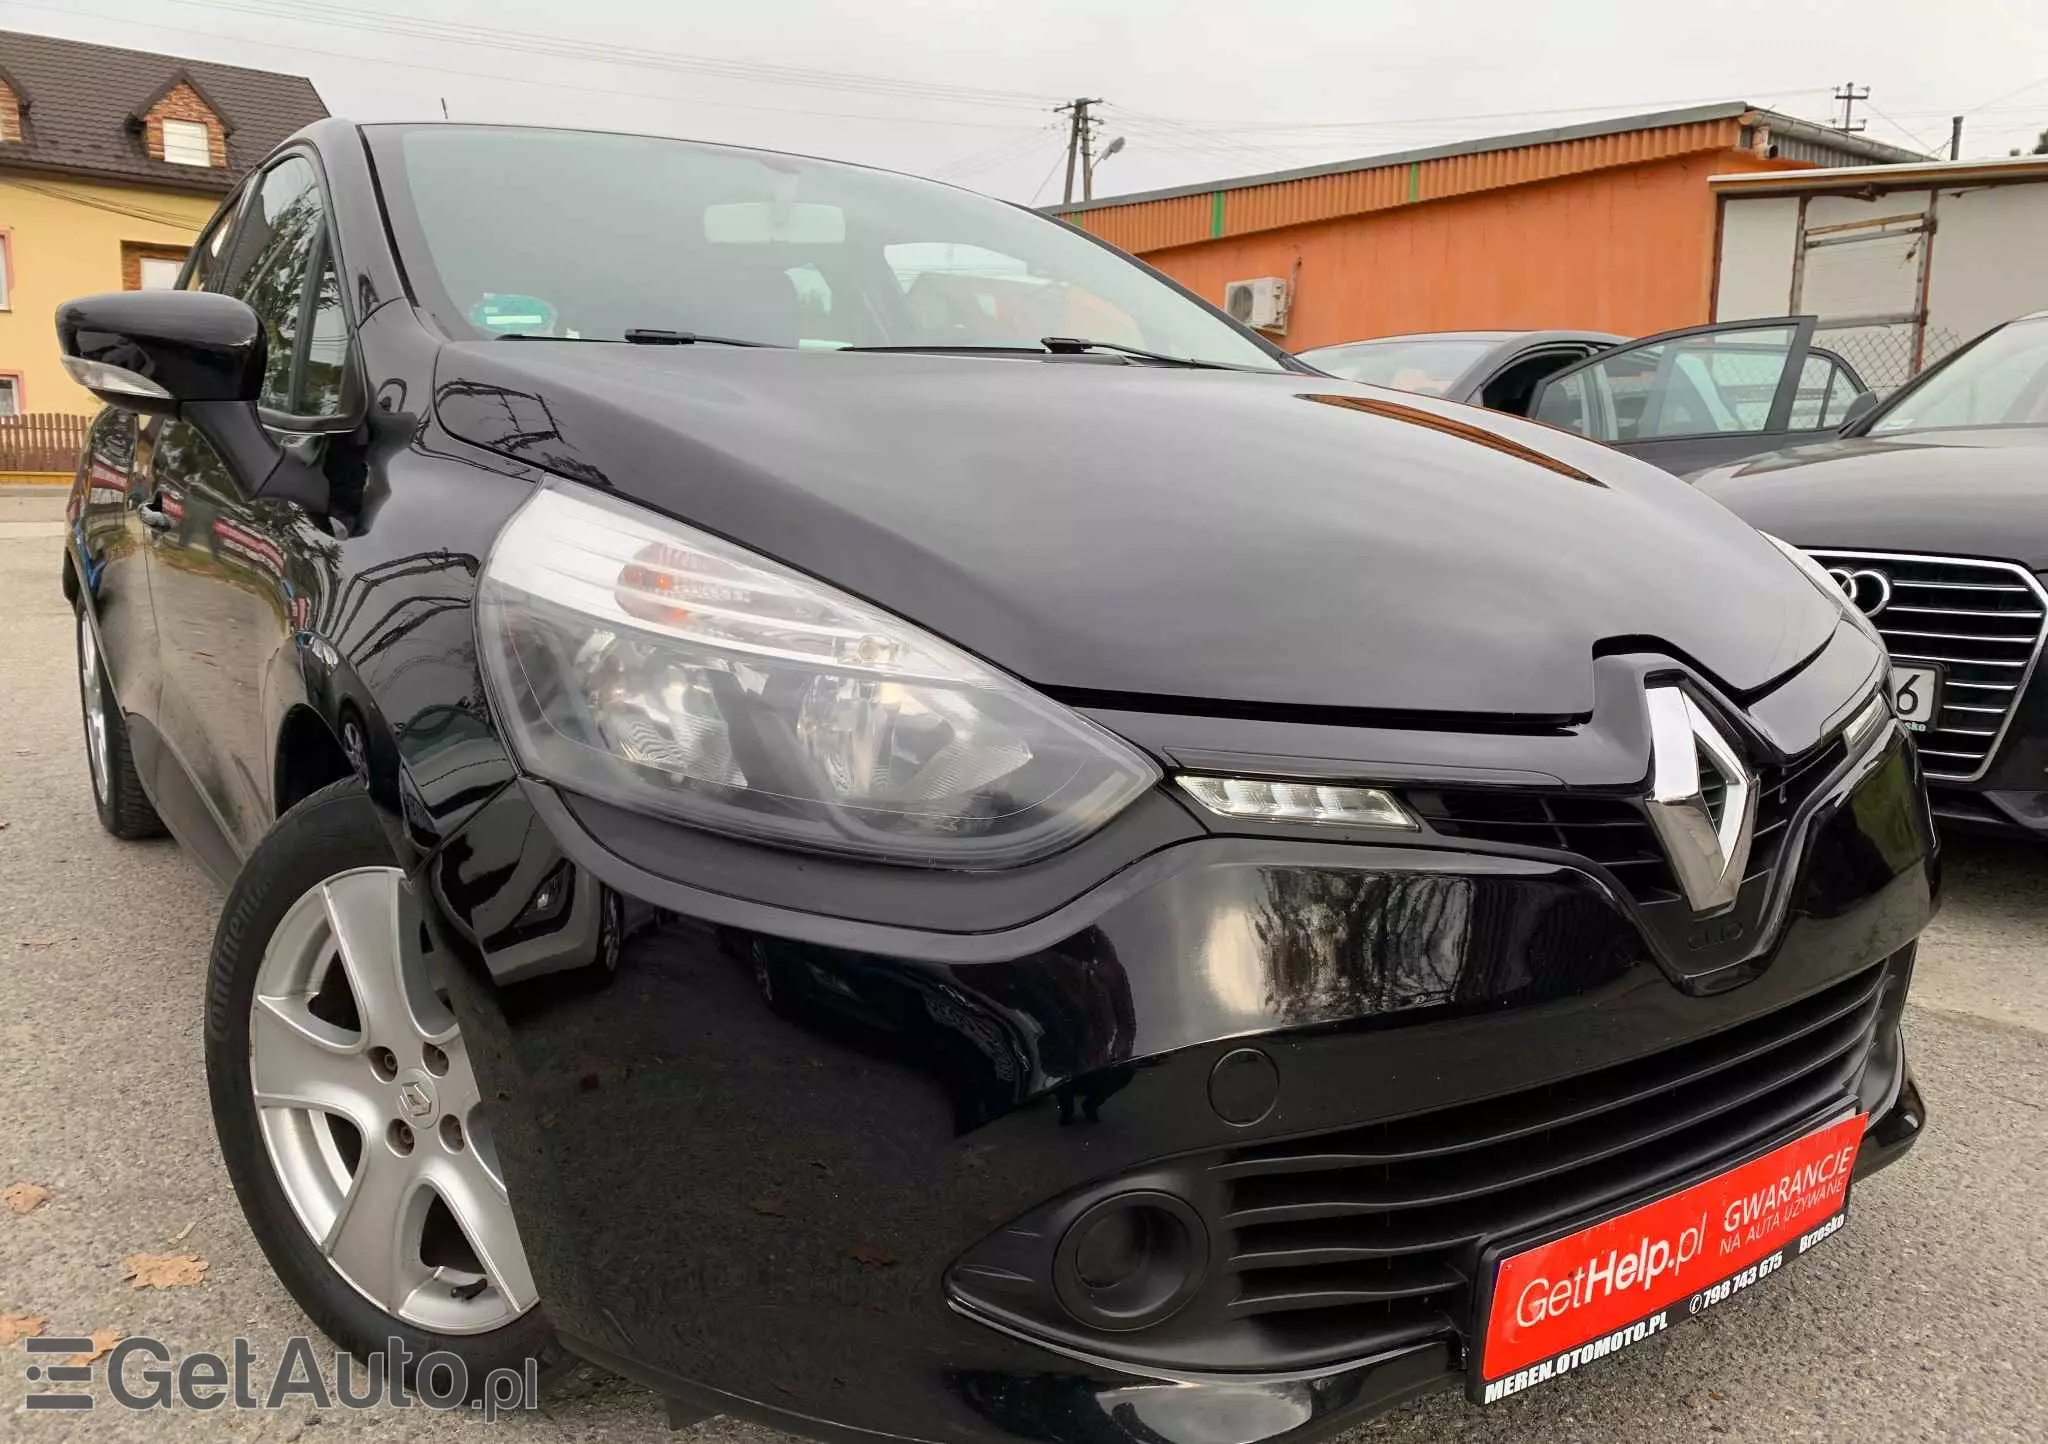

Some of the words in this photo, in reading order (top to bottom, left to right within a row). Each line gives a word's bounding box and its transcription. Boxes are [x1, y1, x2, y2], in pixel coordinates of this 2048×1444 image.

[1688, 920, 1745, 952] CLIO
[1723, 1146, 1854, 1233] GWARANCJE
[1516, 1209, 1708, 1328] GetHelp.pl
[1719, 1233, 1741, 1256] NA
[1745, 1212, 1780, 1246] AUTA
[1484, 1311, 1669, 1404] MEREN.OTOMOTO.PL
[1703, 1279, 1731, 1309] 798
[1732, 1266, 1758, 1293] 743
[1758, 1250, 1783, 1279] 675
[1798, 1213, 1845, 1254] Brzesko
